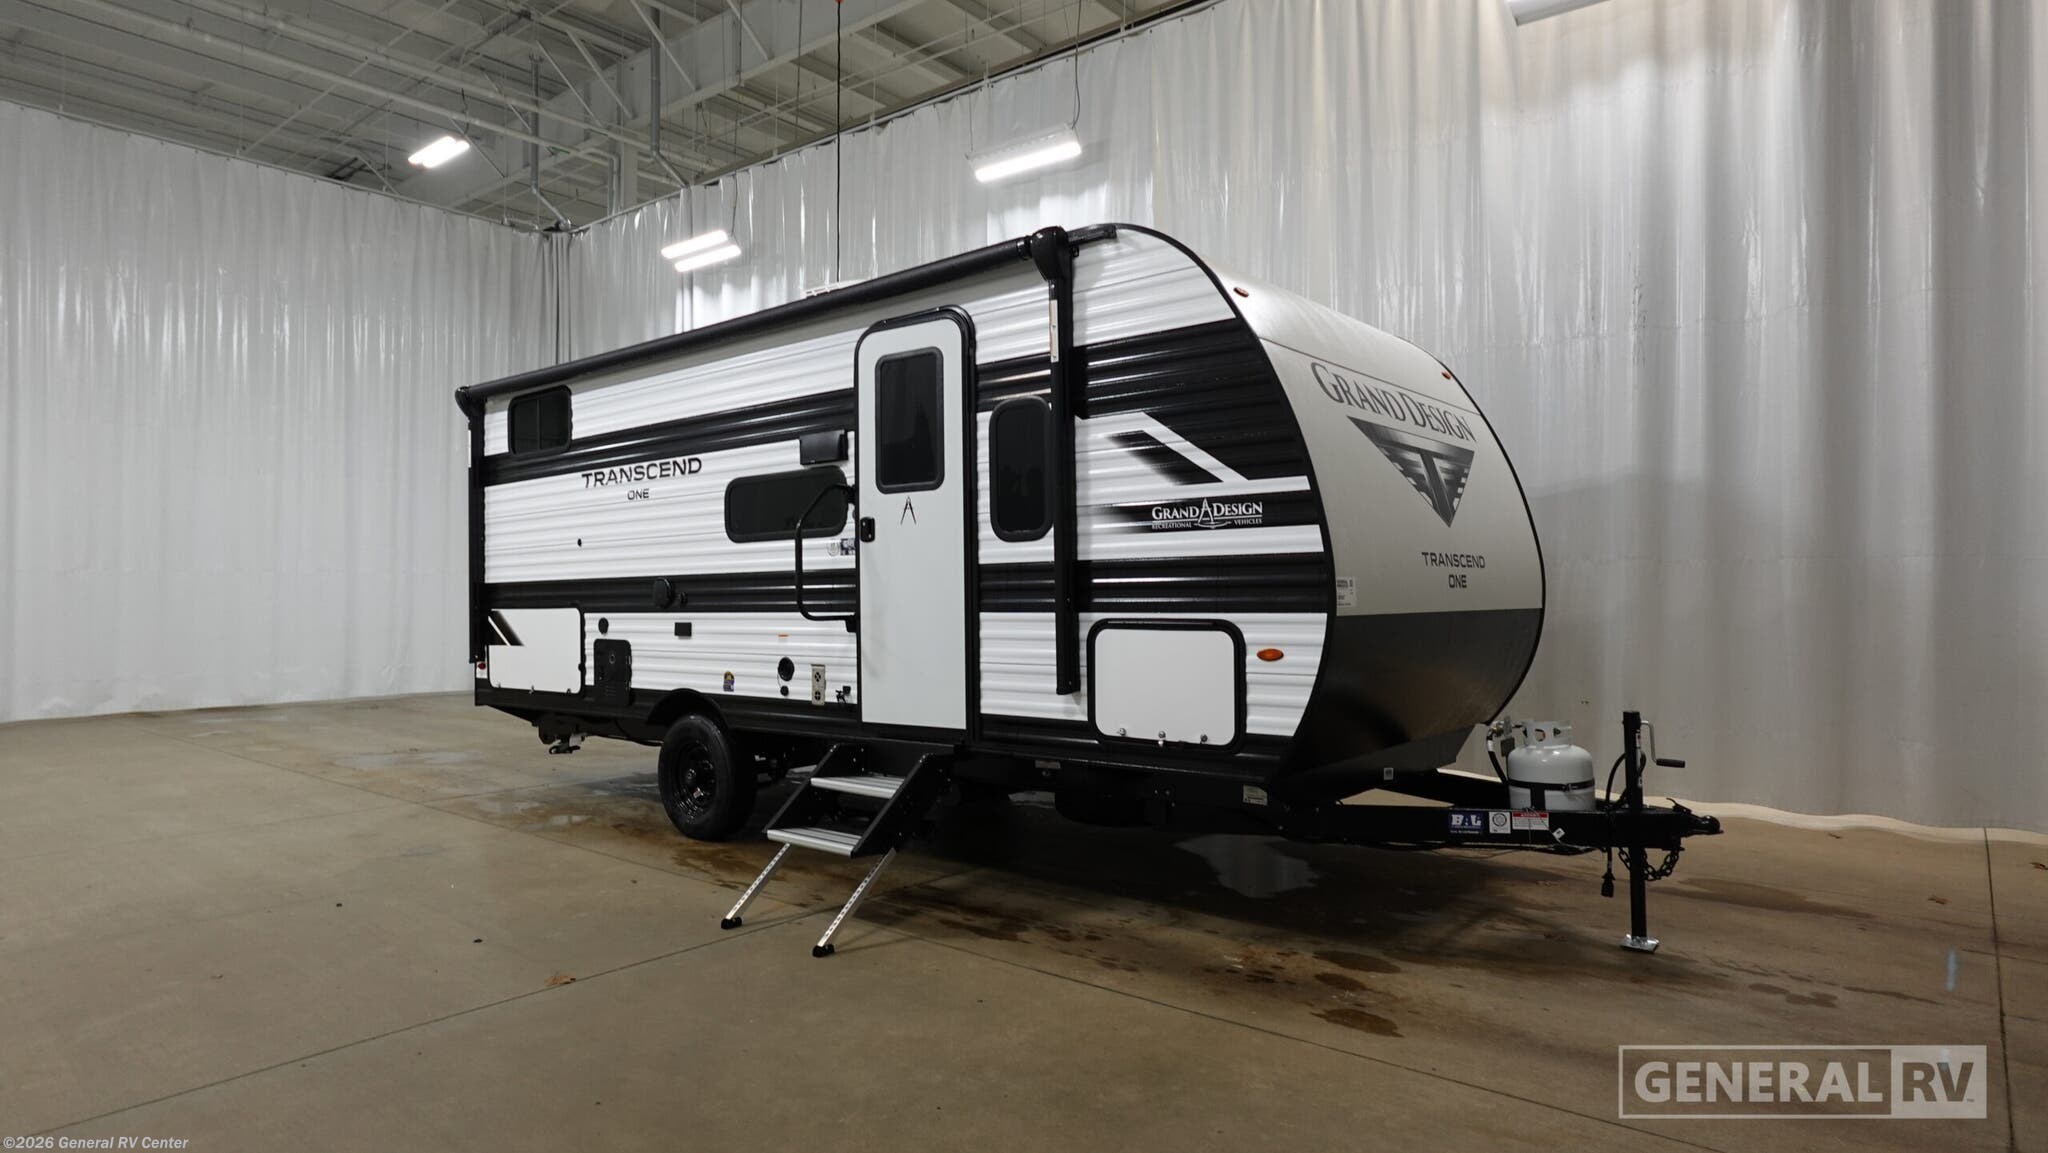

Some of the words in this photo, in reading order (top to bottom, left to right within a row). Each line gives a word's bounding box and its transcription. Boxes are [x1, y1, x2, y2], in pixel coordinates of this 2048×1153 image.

[581, 457, 702, 488] TRANSCEND
[627, 488, 650, 500] ONE
[1421, 552, 1486, 569] TRANSCEND
[1448, 574, 1467, 588] ONE
